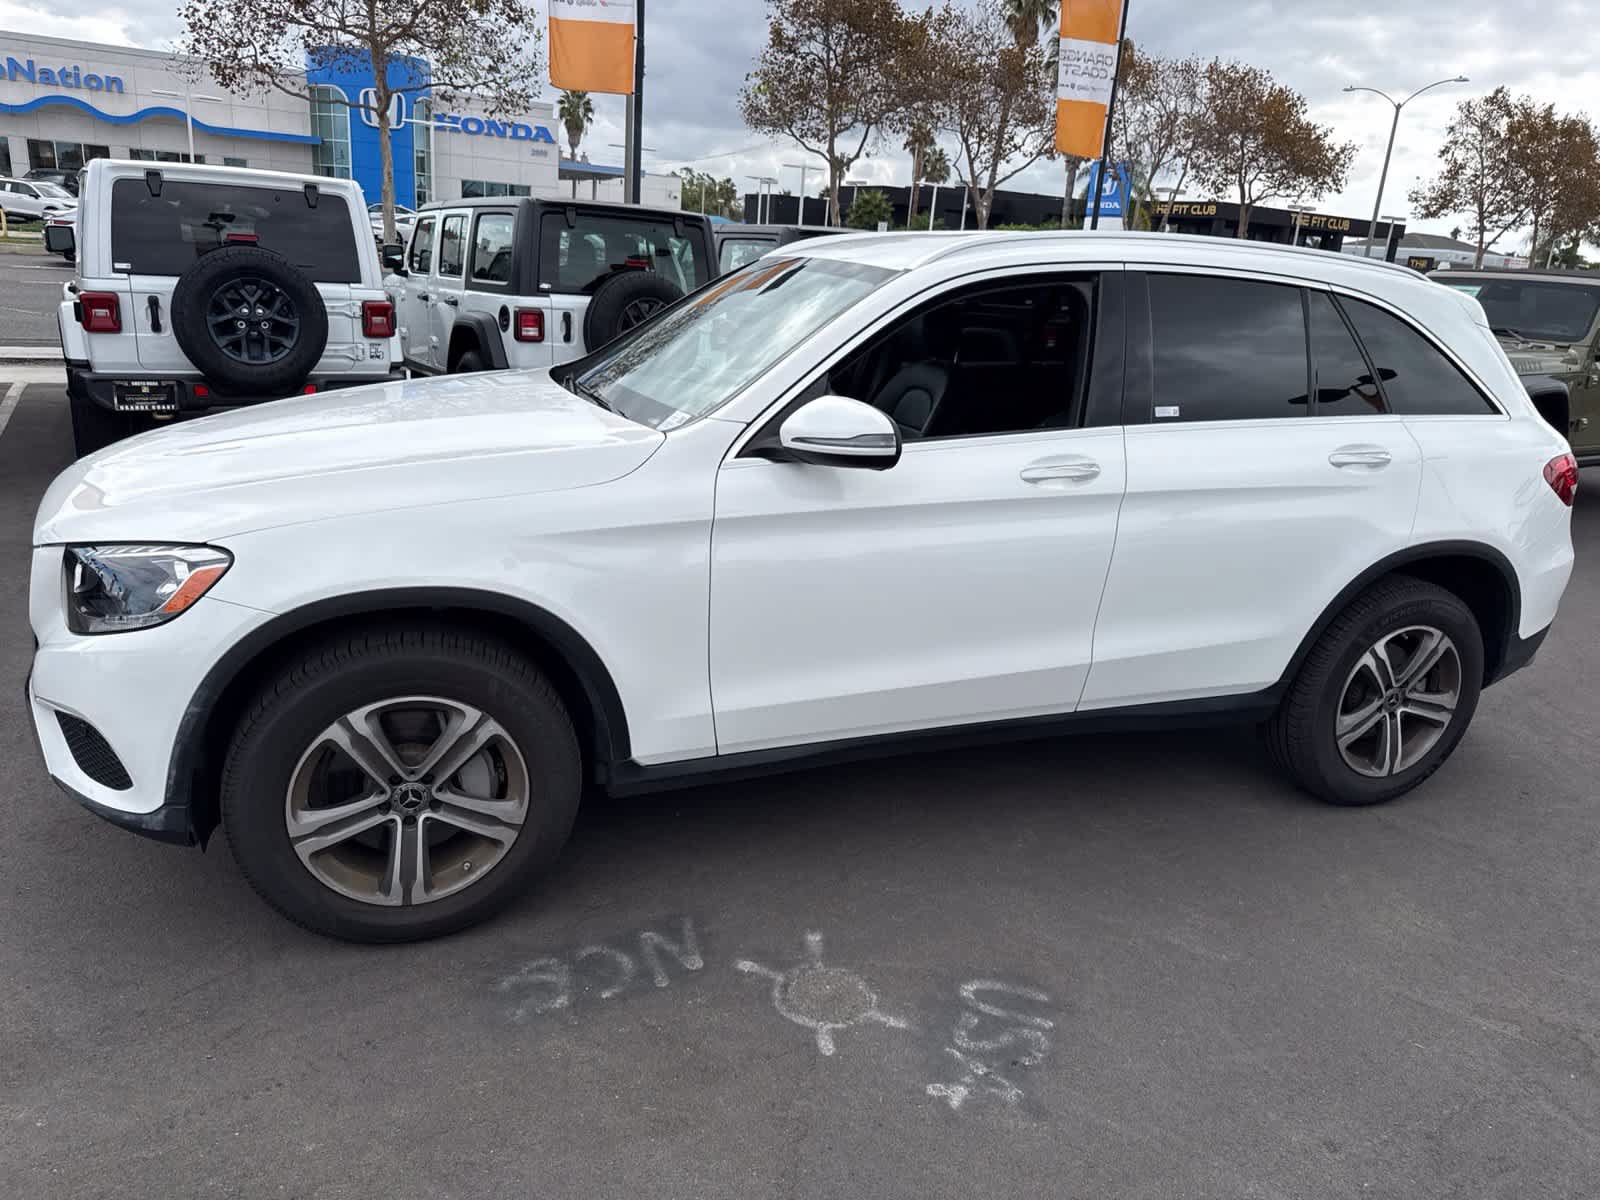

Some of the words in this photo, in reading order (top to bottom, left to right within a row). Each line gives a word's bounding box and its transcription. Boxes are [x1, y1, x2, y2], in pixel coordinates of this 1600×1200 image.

[0, 56, 124, 94] Nation
[433, 113, 557, 145] HONDA
[1172, 204, 1190, 215] FIT
[1190, 205, 1217, 216] CLUB
[1311, 217, 1327, 229] FIT
[1327, 218, 1351, 231] CLUB
